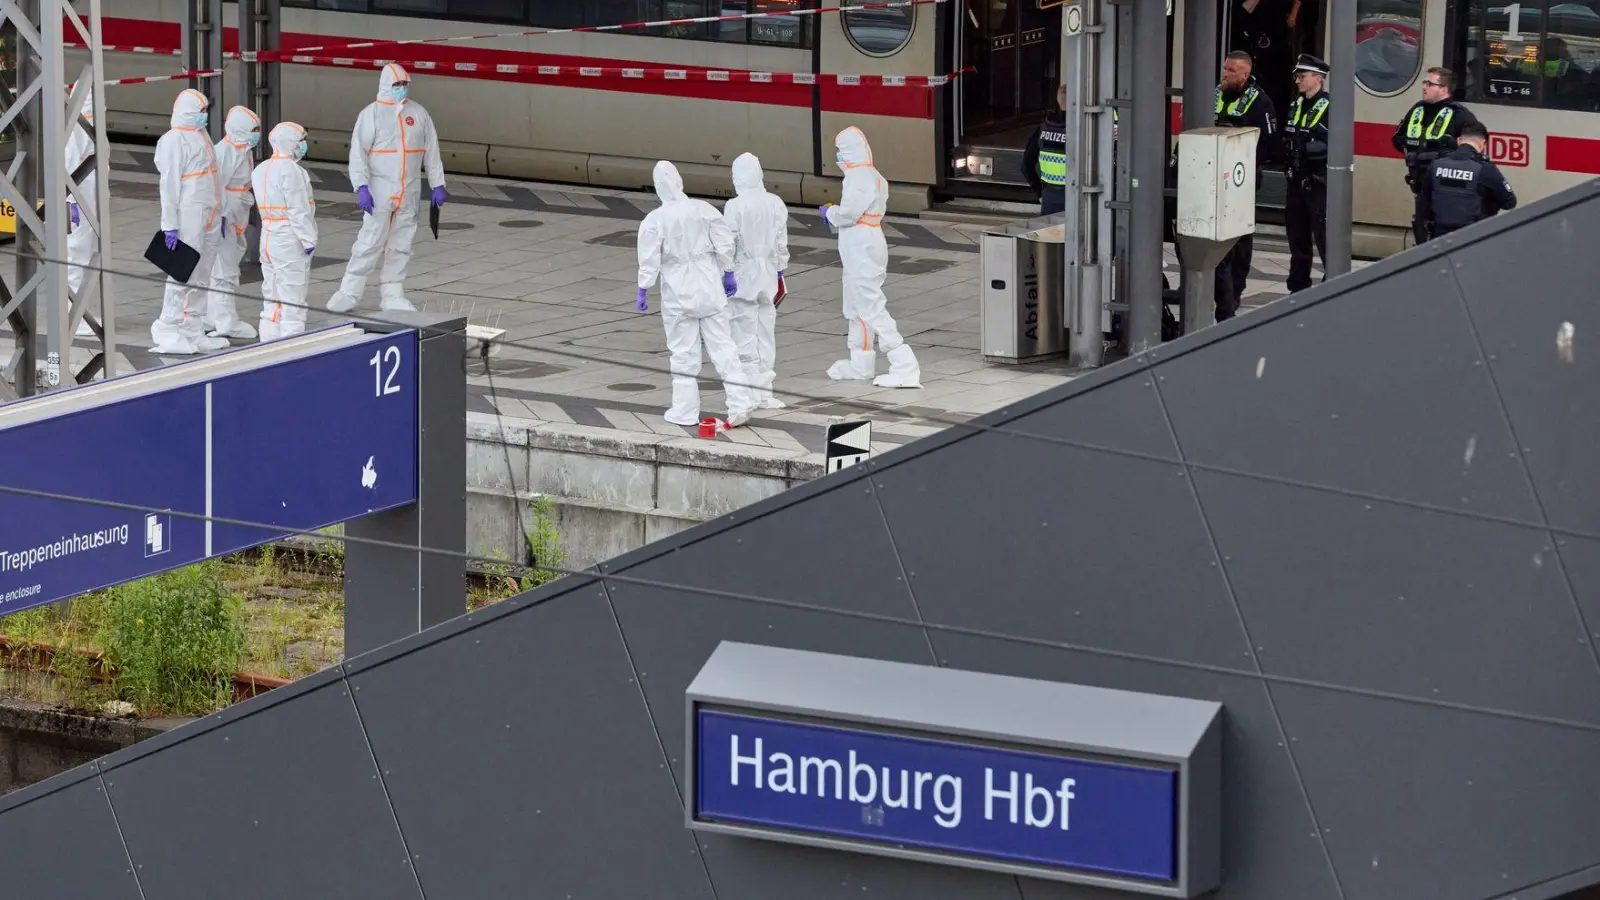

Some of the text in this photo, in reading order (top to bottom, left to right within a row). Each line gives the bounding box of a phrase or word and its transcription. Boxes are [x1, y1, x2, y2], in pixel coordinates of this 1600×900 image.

[782, 29, 793, 37] 108
[1502, 3, 1523, 41] 1
[1503, 86, 1513, 95] 12
[1520, 87, 1531, 96] 66
[1492, 137, 1524, 161] DB
[1436, 167, 1474, 181] POLIZEI
[1025, 273, 1038, 340] Abfall
[370, 345, 401, 397] 12
[0, 524, 129, 573] Treppeneinhausung
[5, 583, 42, 603] enclosure
[731, 734, 1076, 830] Hamburg Hbf
